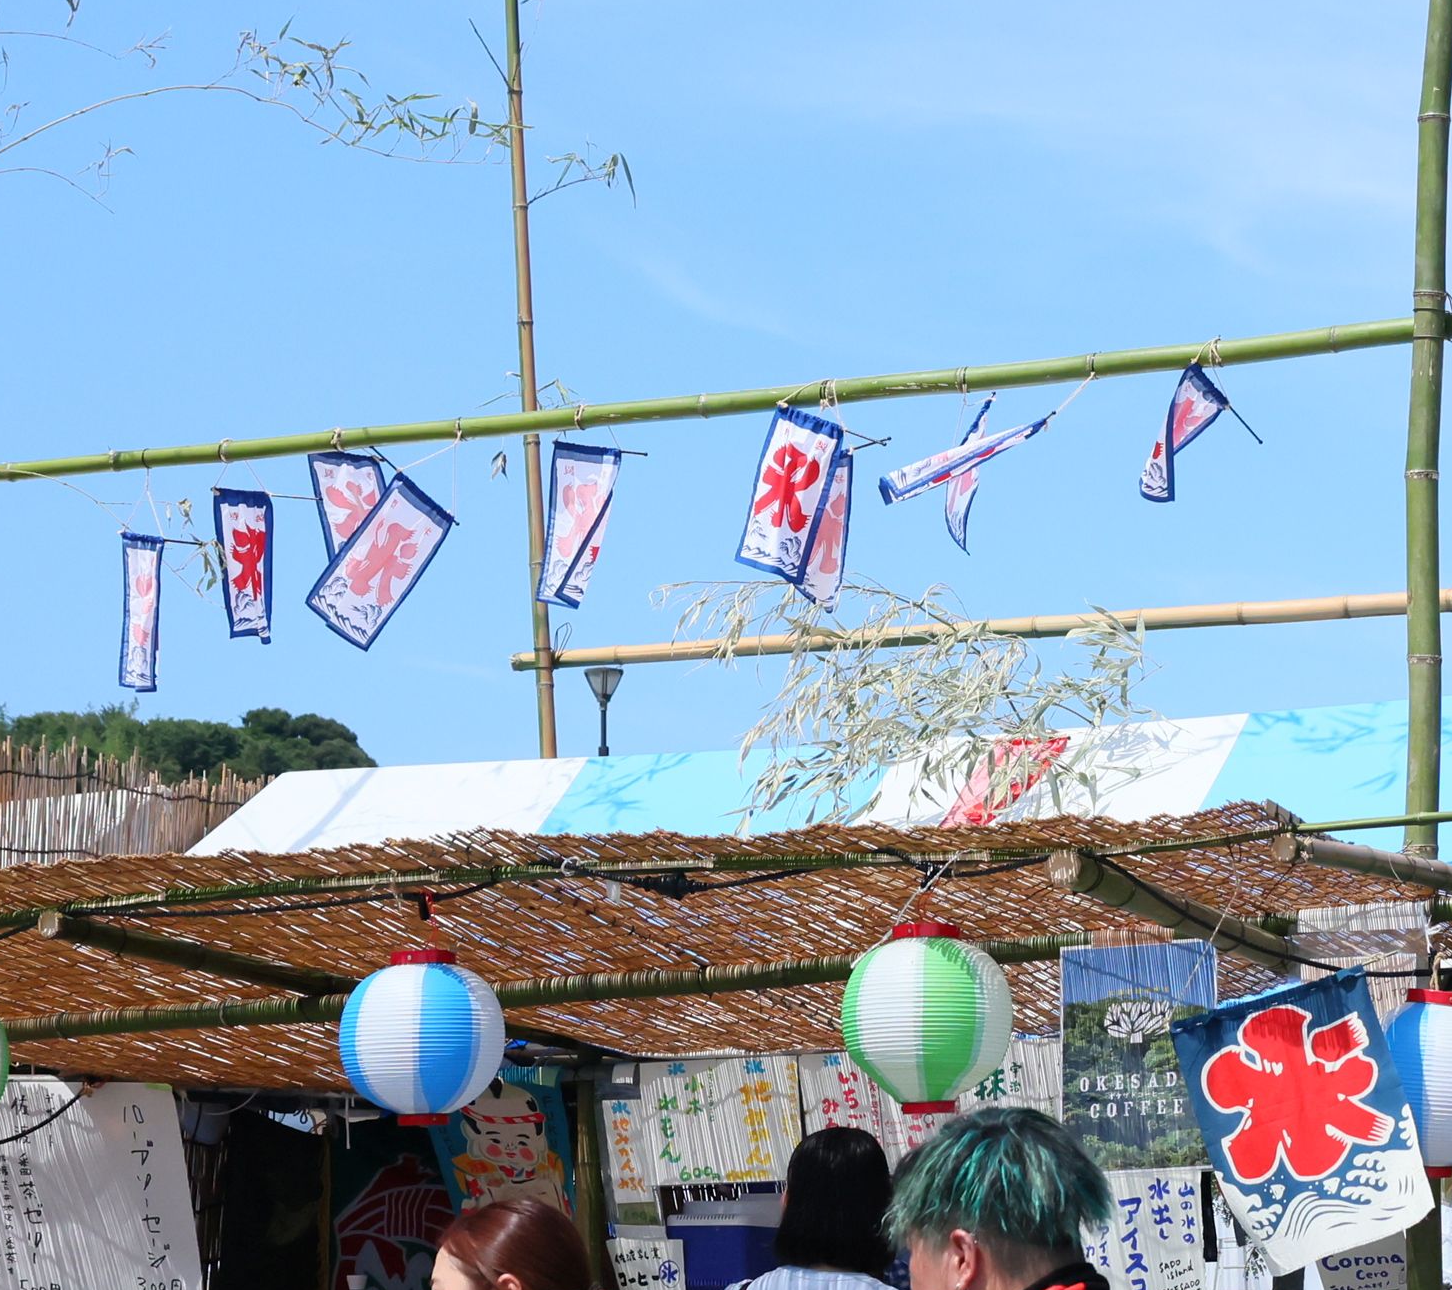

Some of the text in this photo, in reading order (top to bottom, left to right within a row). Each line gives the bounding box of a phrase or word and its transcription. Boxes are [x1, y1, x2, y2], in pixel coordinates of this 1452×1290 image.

[754, 442, 821, 534] 氷
[1079, 1071, 1178, 1093] OKESAD
[1203, 1005, 1394, 1184] 氷
[1090, 1098, 1184, 1119] COFFEE
[1148, 1177, 1174, 1241] 水出し
[1178, 1180, 1196, 1244] 山の水の
[1159, 1258, 1181, 1274] SADO
[1321, 1253, 1405, 1271] Corona
[618, 1271, 660, 1287] コーヒー
[1355, 1269, 1389, 1280] Cero
